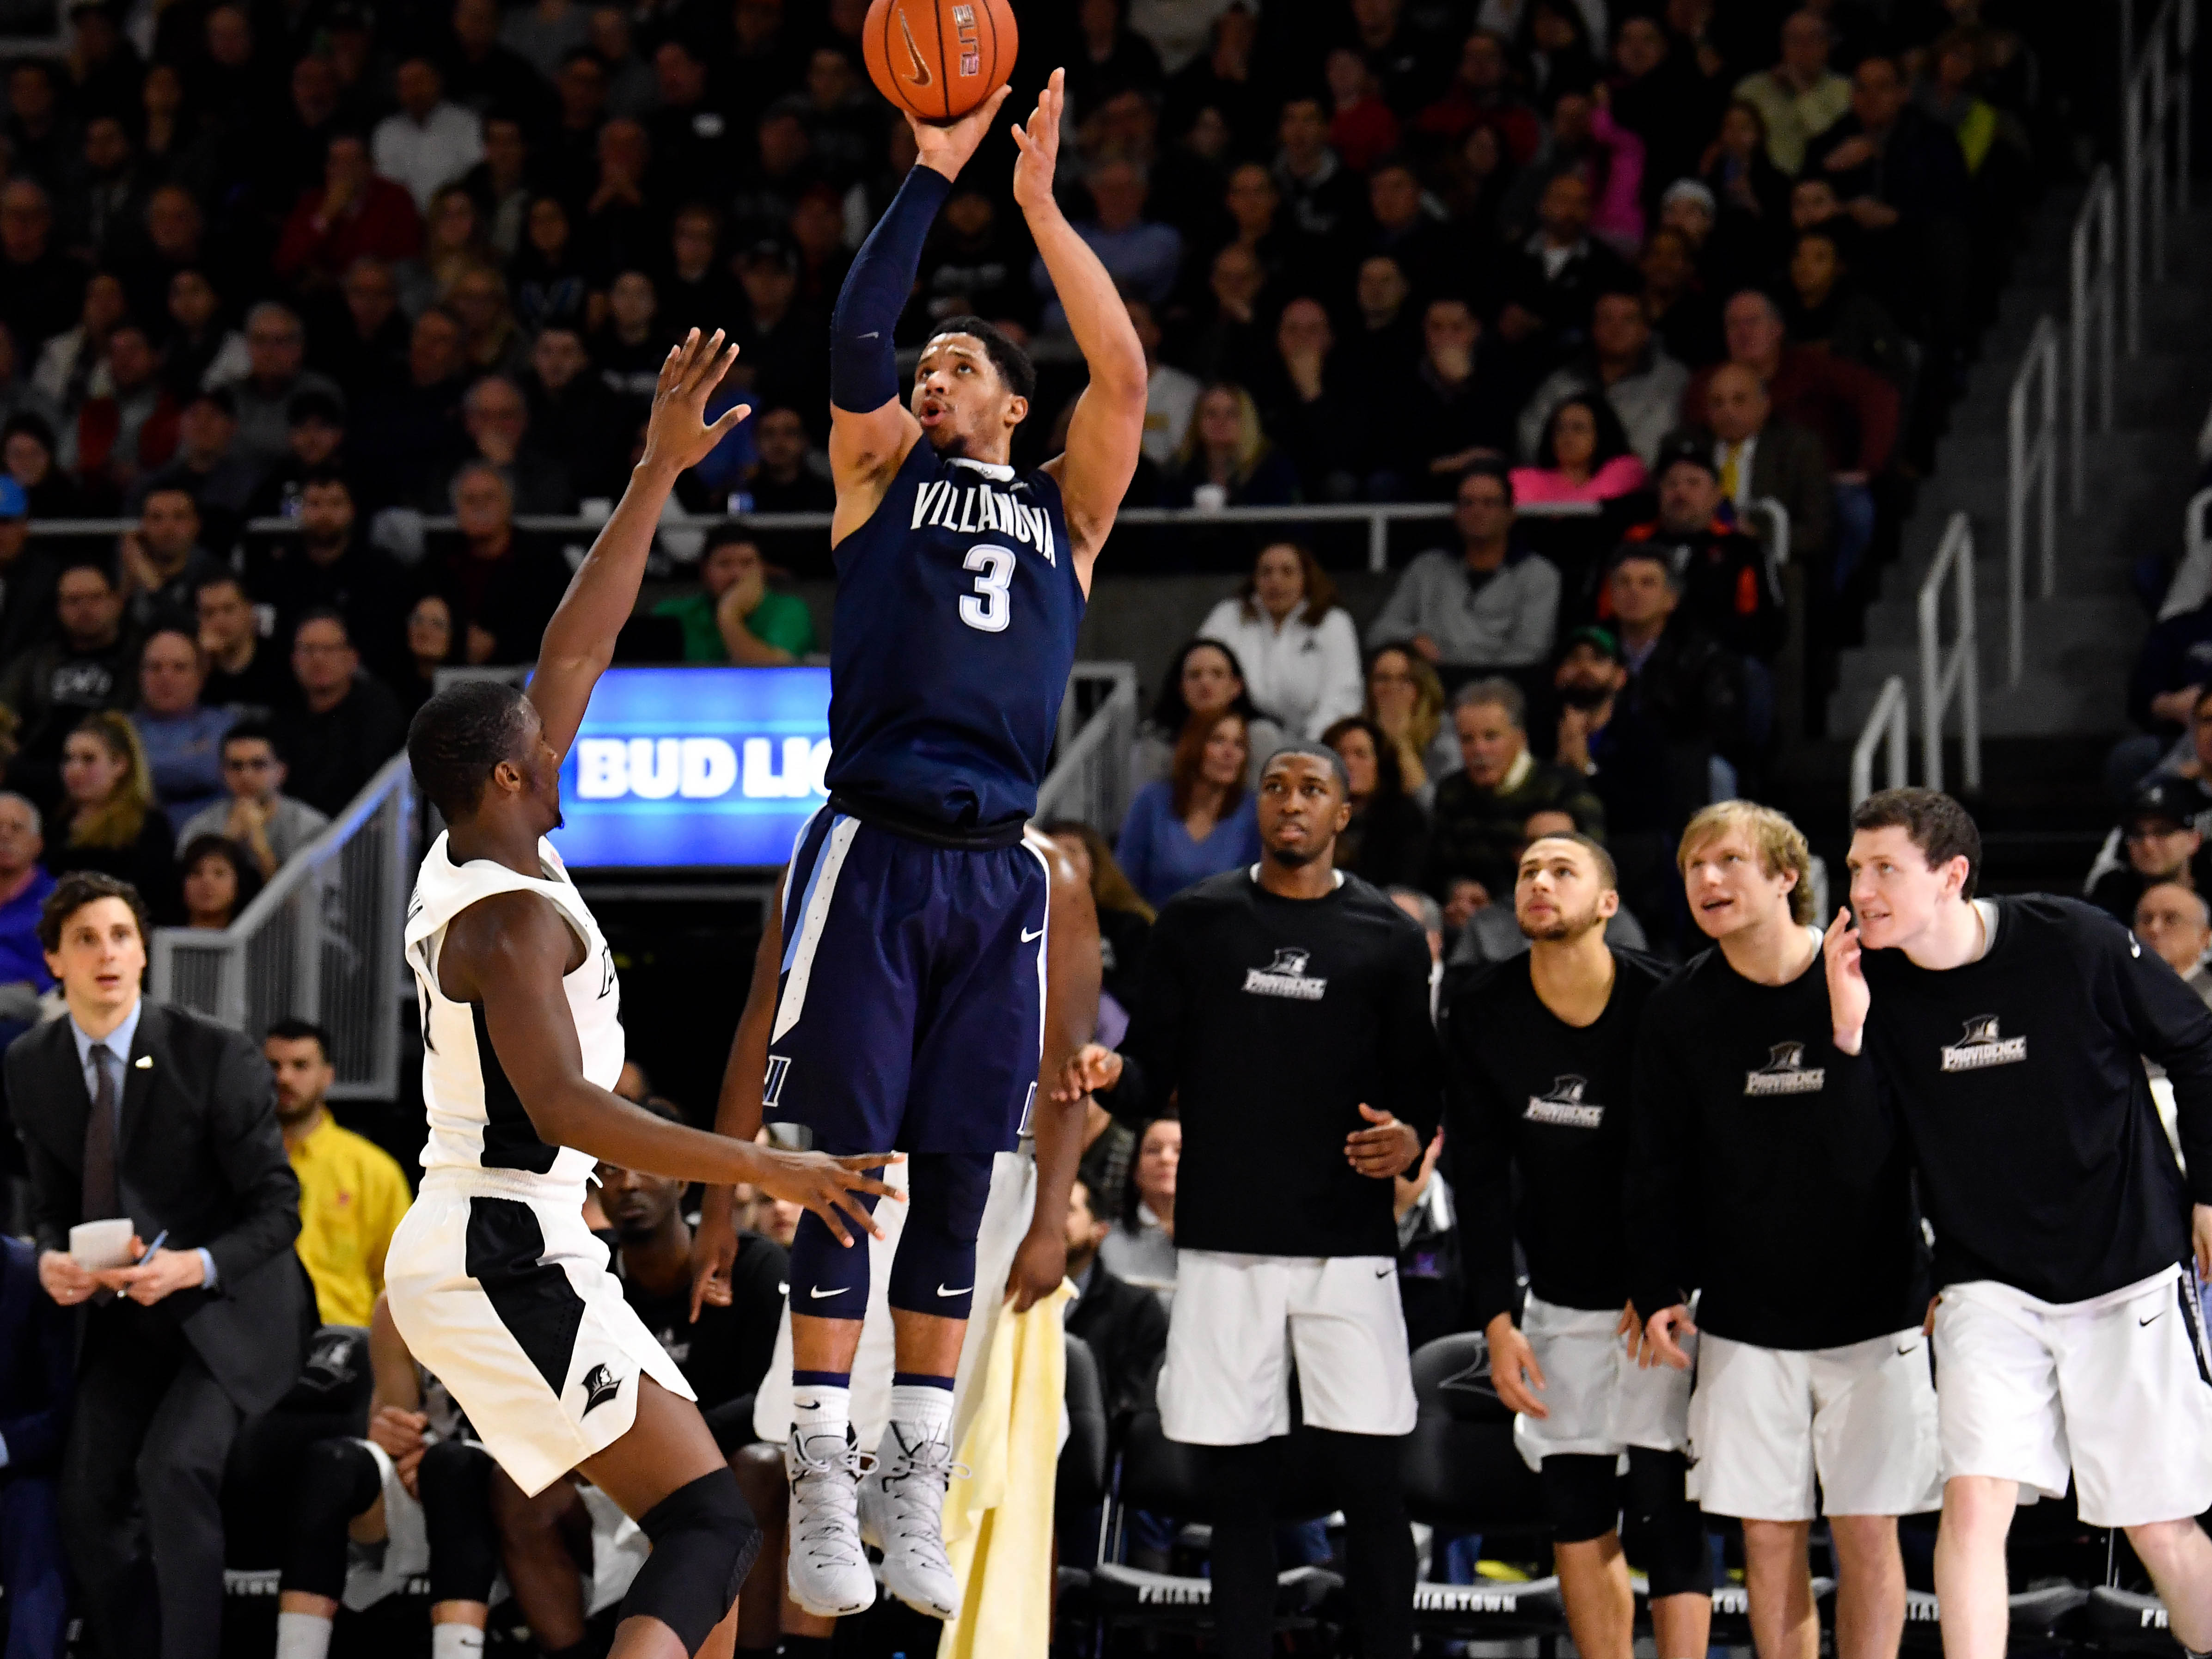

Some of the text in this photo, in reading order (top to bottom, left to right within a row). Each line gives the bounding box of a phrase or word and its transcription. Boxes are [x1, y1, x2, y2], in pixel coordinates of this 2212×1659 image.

[953, 5, 979, 76] ELITE
[910, 479, 1057, 568] VILLANOVA
[959, 544, 1016, 633] 3
[578, 737, 737, 799] BUD
[1941, 1035, 2027, 1072] PROVIDENCE
